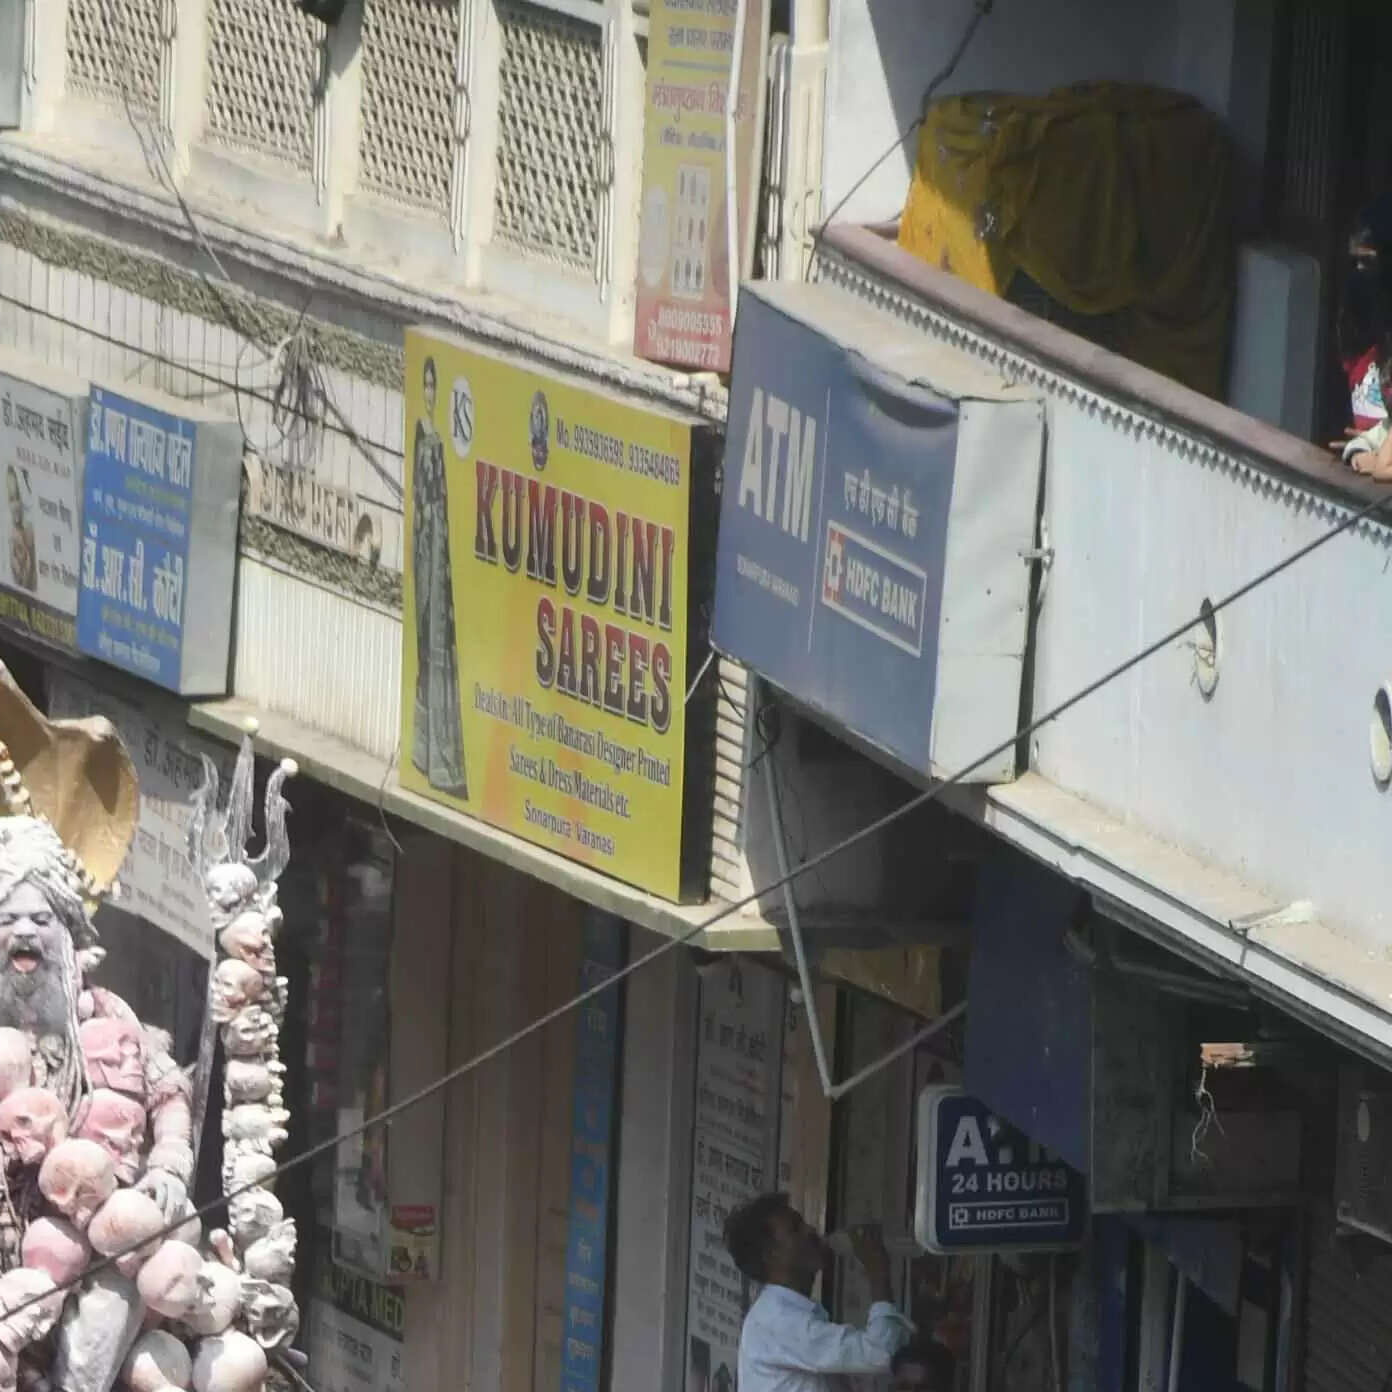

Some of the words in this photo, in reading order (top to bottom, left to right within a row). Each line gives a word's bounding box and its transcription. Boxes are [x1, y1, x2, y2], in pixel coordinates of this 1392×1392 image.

[738, 387, 816, 544] ATM
[474, 460, 674, 632] KUMUDINI
[845, 553, 879, 608] HDFC
[881, 574, 918, 630] BANK
[536, 596, 672, 735] SAREES
[510, 745, 538, 782] Sarees
[548, 759, 573, 795] Dress
[575, 770, 614, 813] Materials
[524, 699, 545, 742] Type
[558, 714, 595, 756] Banarasi
[597, 730, 636, 775] Designer
[638, 748, 671, 786] Printed
[525, 799, 572, 837] Sonarpura
[577, 820, 615, 856] Varanasi
[952, 1173, 979, 1194] 24
[987, 1168, 1067, 1192] HOURS
[976, 1208, 1015, 1221] HDFC
